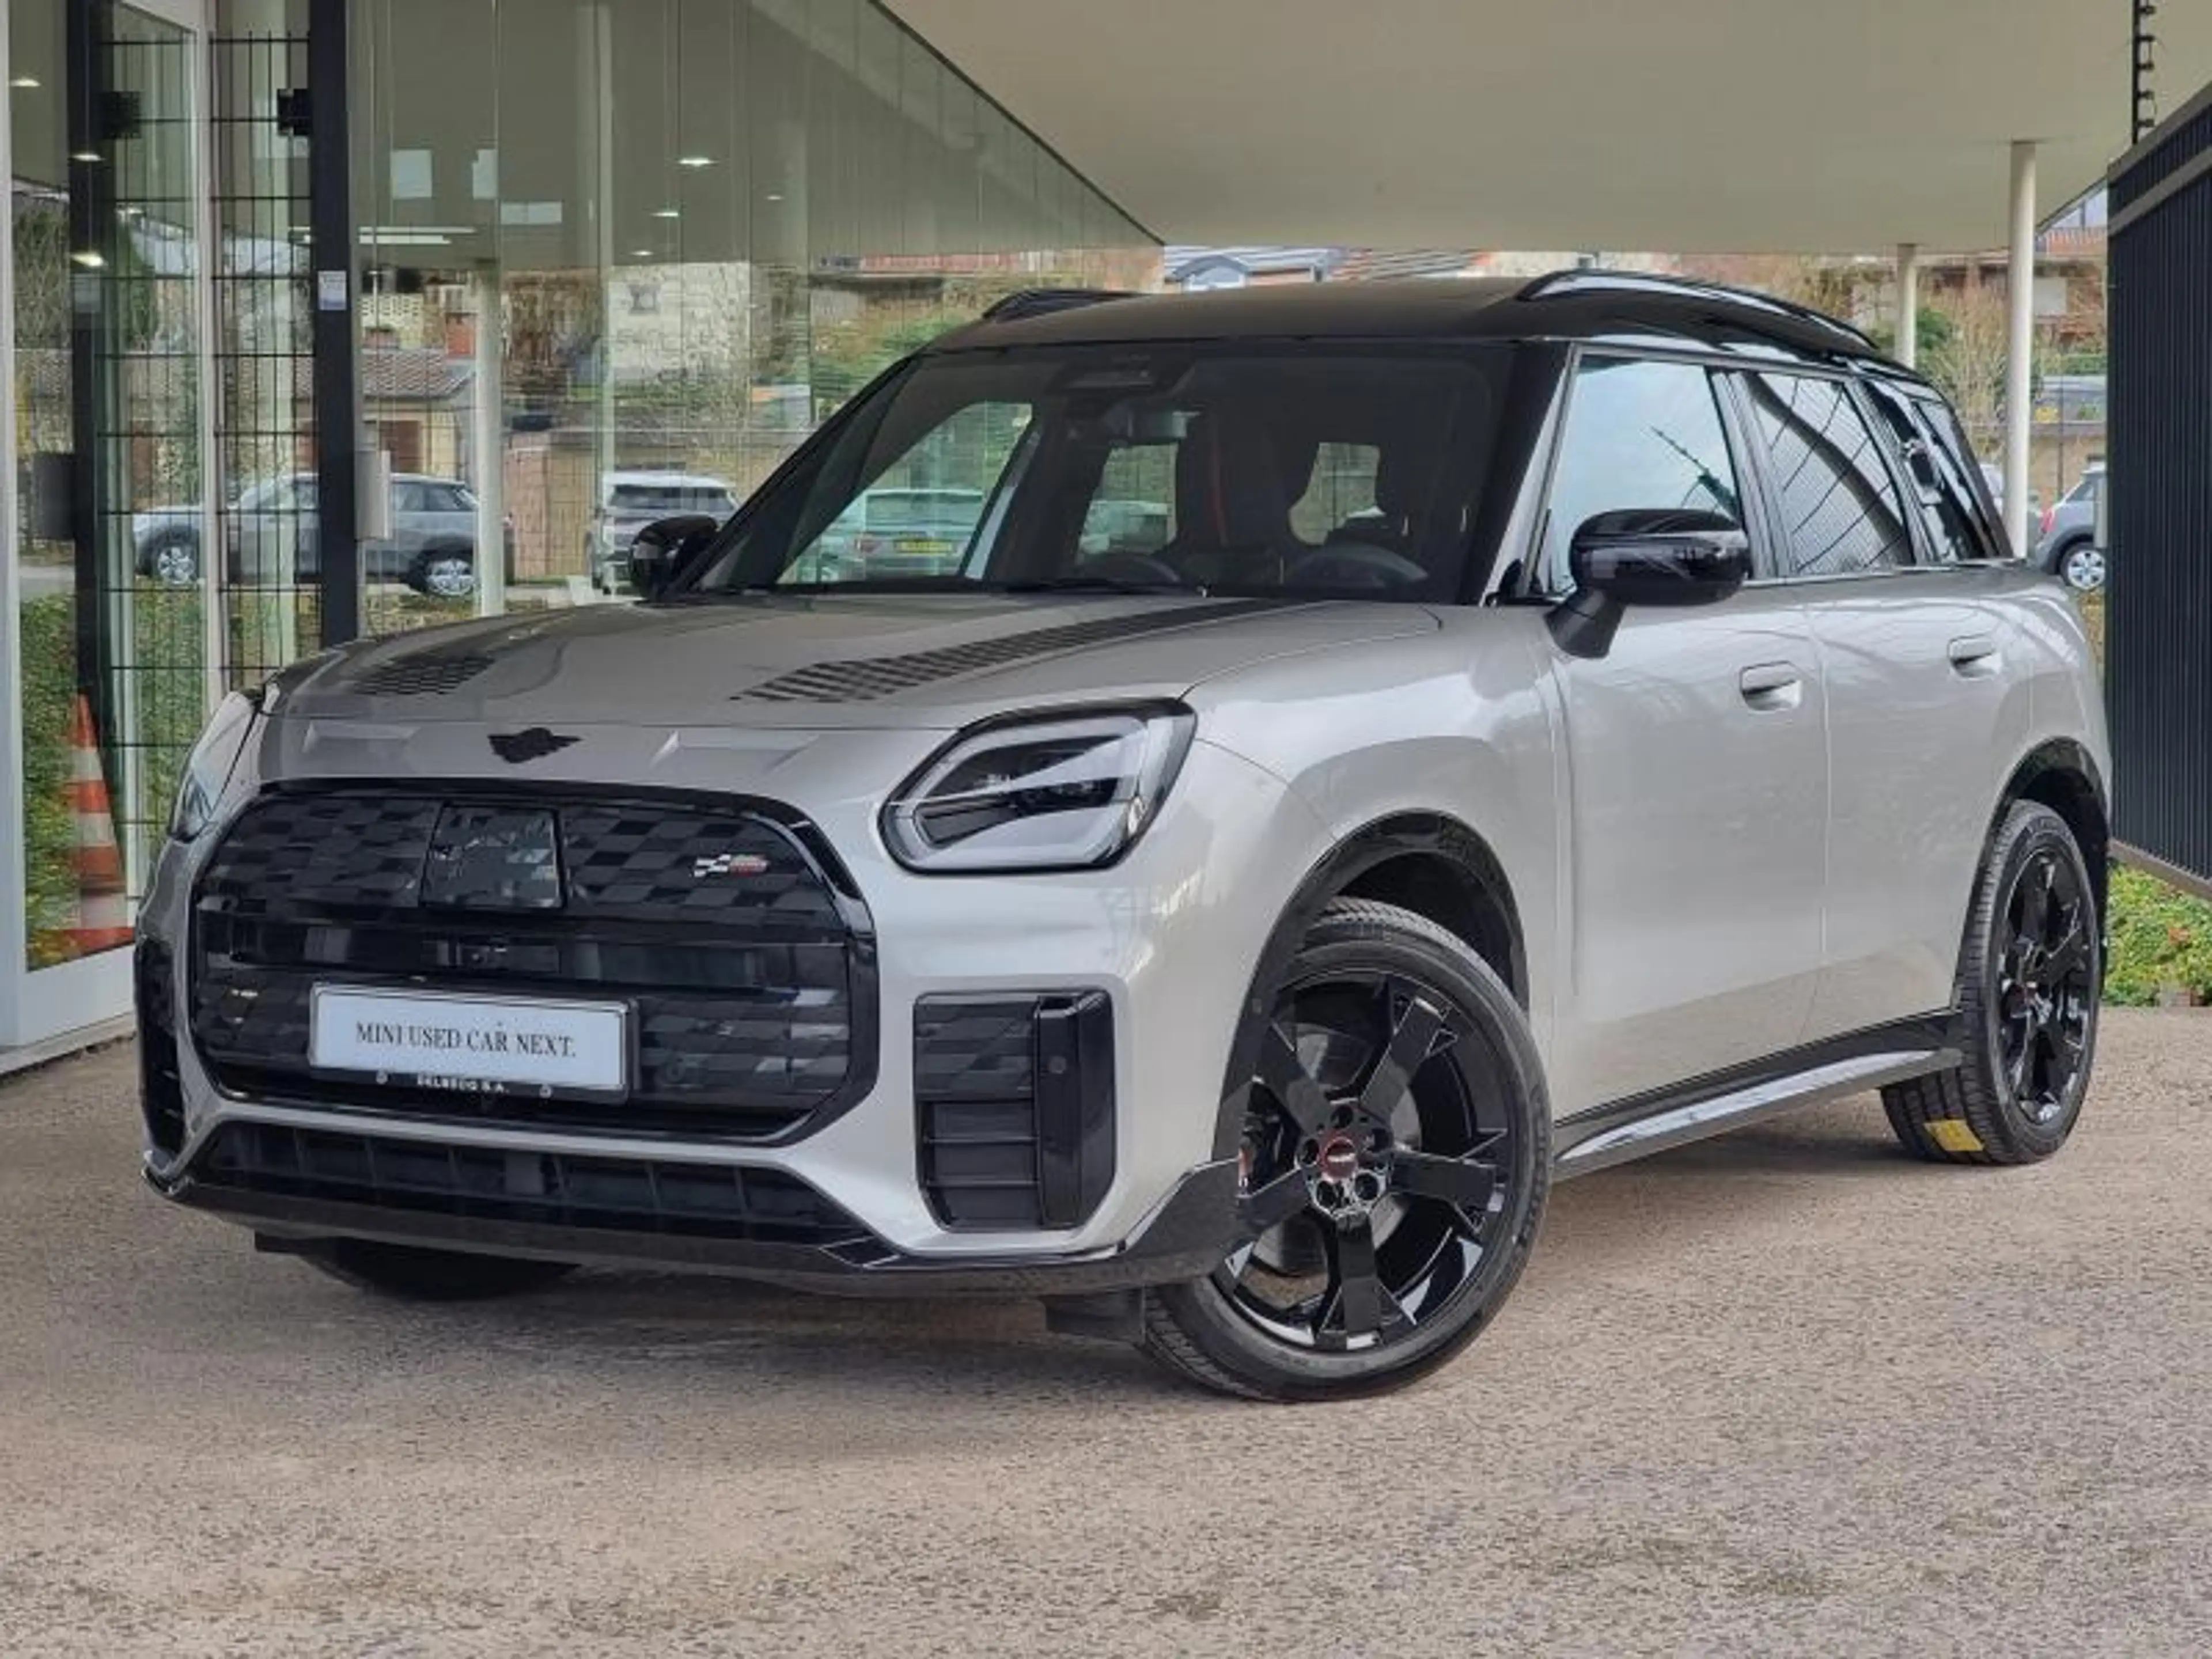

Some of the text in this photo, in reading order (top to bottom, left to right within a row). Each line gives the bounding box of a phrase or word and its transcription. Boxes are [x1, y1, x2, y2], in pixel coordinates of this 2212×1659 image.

[356, 1022, 577, 1058] MINI USED CAR NEXT.
